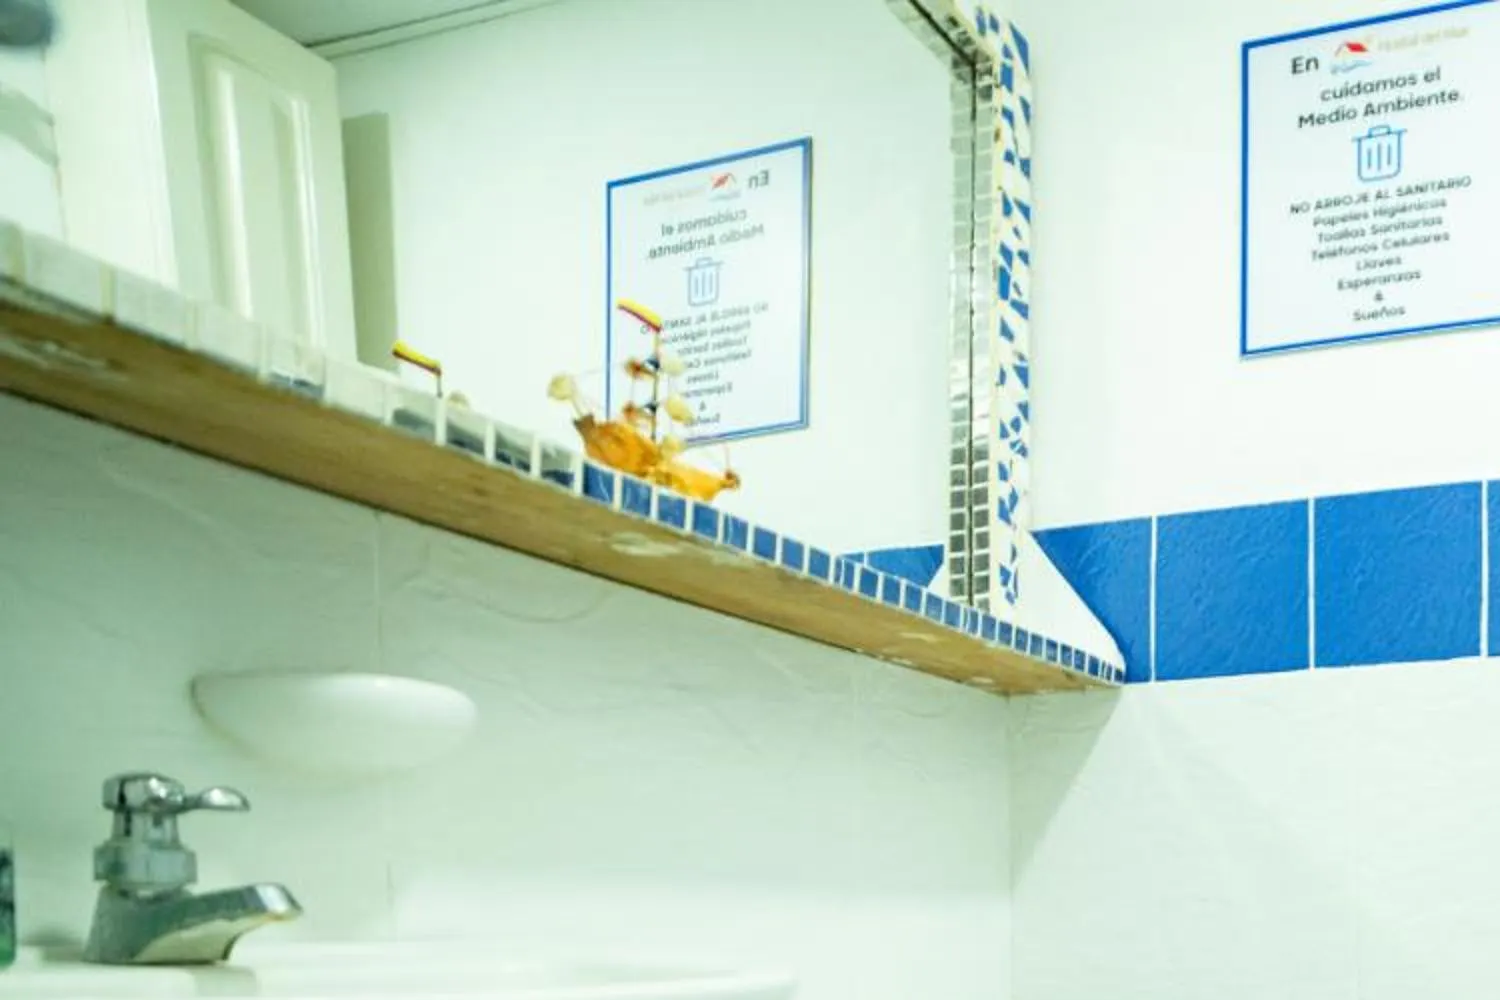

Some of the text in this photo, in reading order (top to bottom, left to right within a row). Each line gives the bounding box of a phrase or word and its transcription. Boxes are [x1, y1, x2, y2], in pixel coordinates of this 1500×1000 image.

[1290, 55, 1320, 75] En
[1320, 66, 1441, 102] cuidamos el
[1298, 105, 1357, 129] Medio
[1290, 175, 1472, 215] NO ARROJE AL SANITARIO
[1312, 212, 1369, 229] Papeles
[1317, 216, 1443, 243] Toallas Sanitarias
[1382, 231, 1450, 250] Celulares
[1355, 256, 1402, 271] Llaves
[1337, 269, 1421, 292] Esperanzas
[1352, 305, 1405, 321] Sueños
